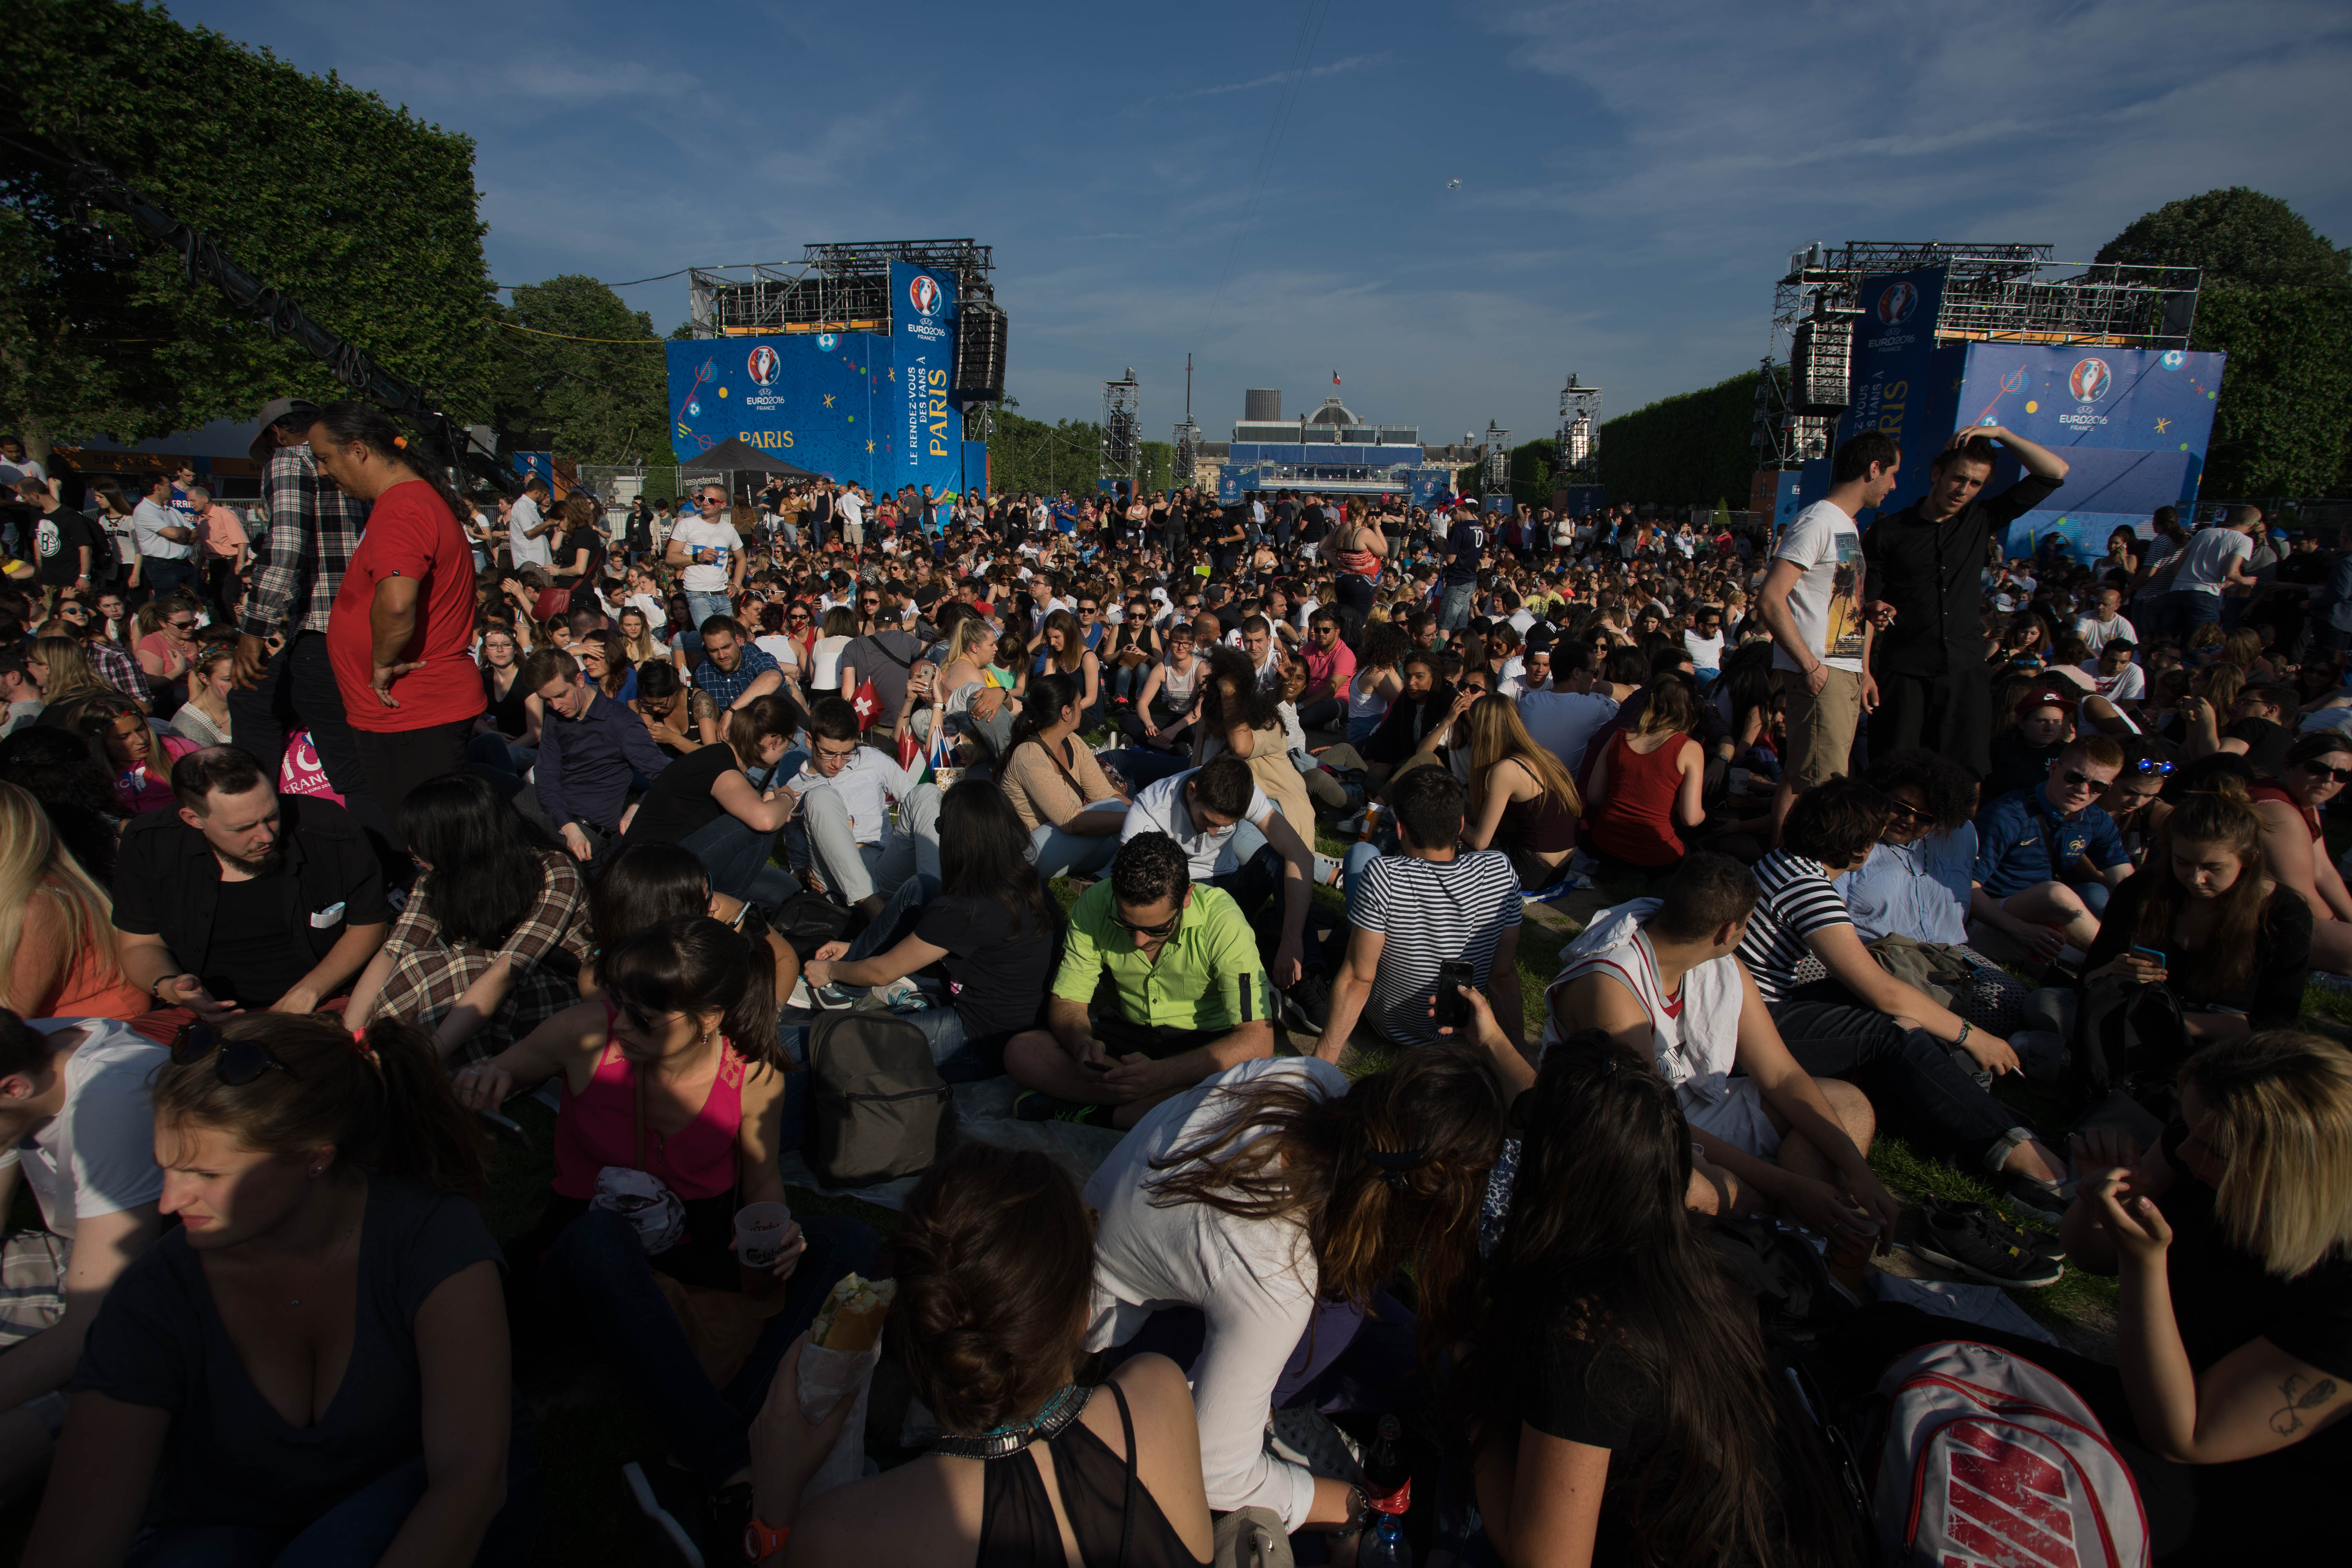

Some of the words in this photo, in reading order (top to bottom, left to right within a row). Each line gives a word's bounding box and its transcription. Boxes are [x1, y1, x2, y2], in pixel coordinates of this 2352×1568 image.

[907, 323, 945, 336] EURO2016
[1868, 334, 1915, 348] EURO2016
[916, 356, 926, 365] À
[918, 367, 927, 398] FANS
[746, 396, 785, 405] EURO2016
[908, 367, 918, 448] RENDEZ-VOUS
[1868, 383, 1882, 416] FANS
[919, 399, 927, 423] DES
[928, 370, 948, 456] PARIS
[2059, 415, 2108, 425] EURO2016
[740, 430, 794, 448] PARIS
[910, 452, 918, 466] LE
[42, 533, 49, 552] B
[1474, 529, 1483, 548] 10
[1235, 637, 1242, 648] 3
